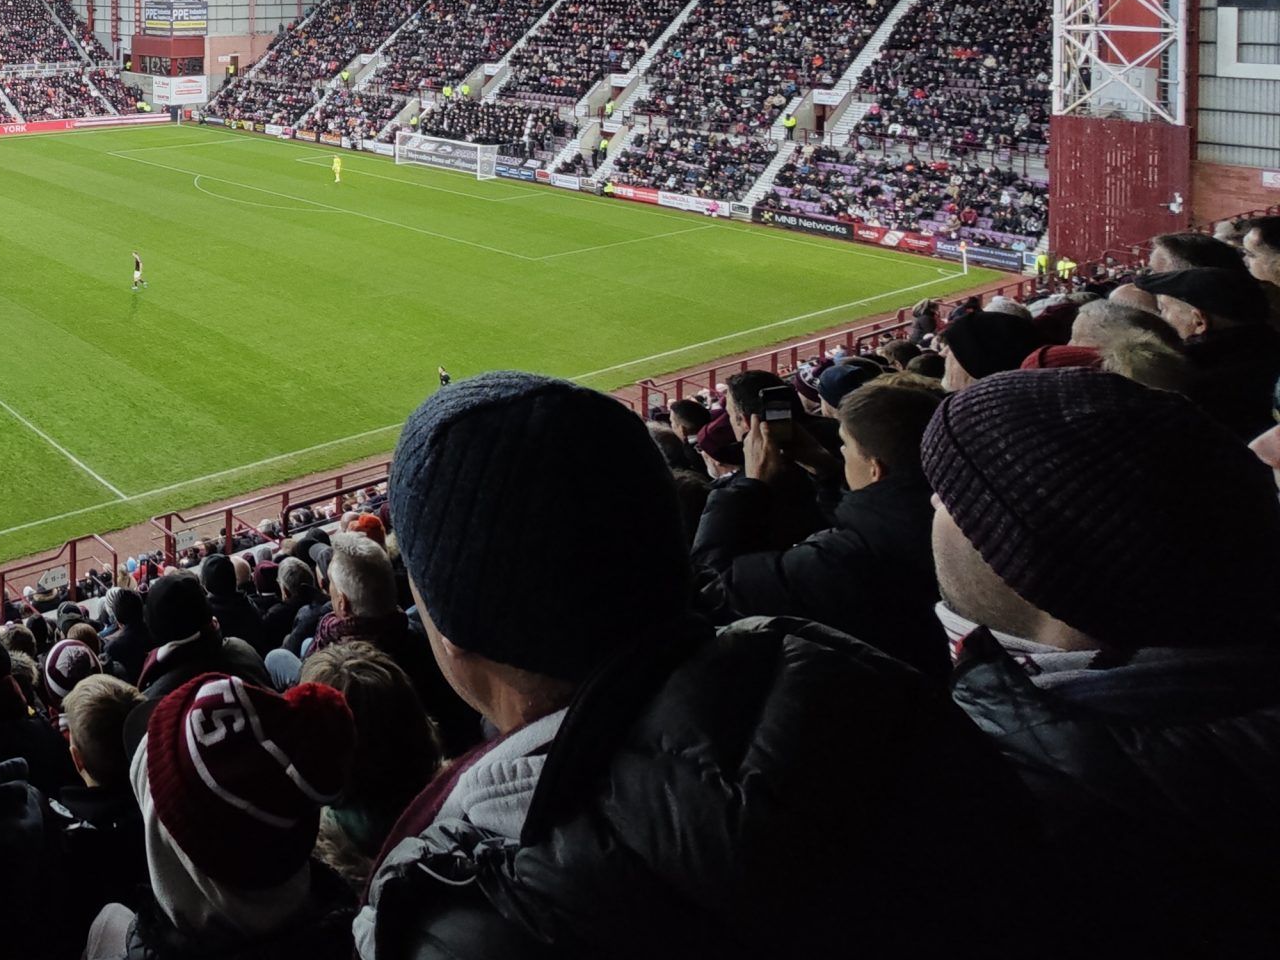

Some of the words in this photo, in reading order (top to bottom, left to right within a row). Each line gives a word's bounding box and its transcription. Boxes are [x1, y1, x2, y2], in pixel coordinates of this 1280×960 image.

[146, 9, 158, 20] PPE
[173, 9, 189, 20] PPE
[3, 124, 27, 134] YORK
[775, 214, 797, 225] MNB
[799, 218, 847, 234] Networks
